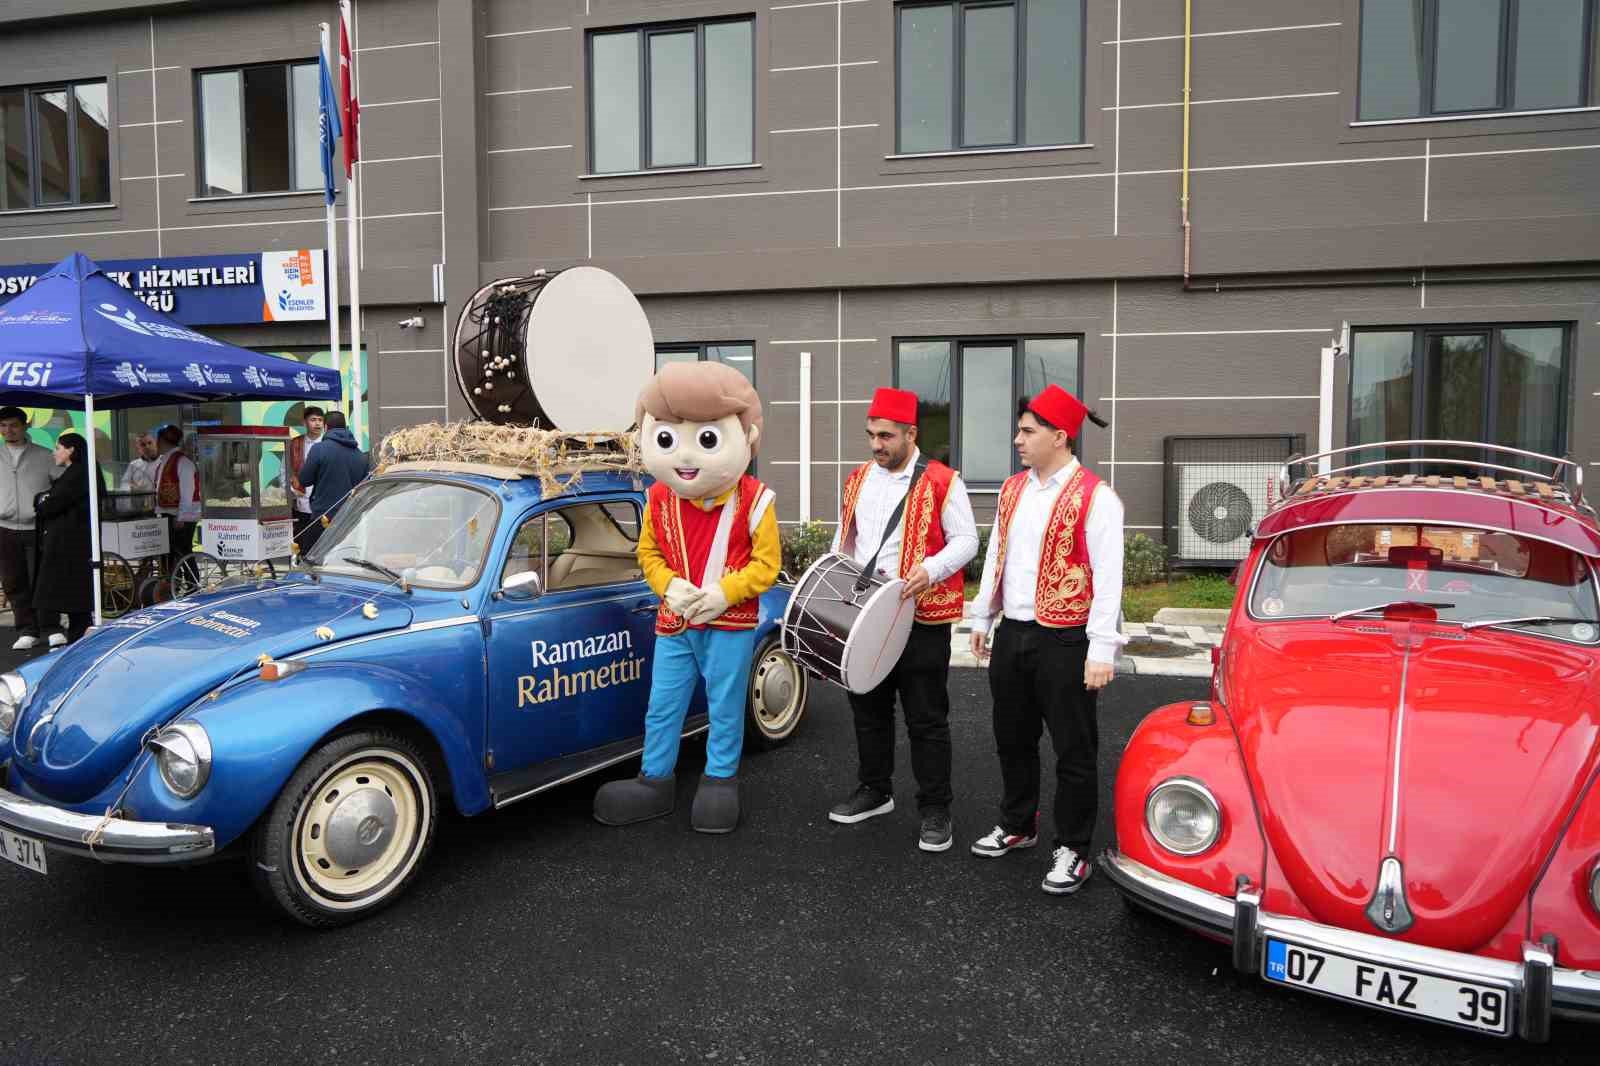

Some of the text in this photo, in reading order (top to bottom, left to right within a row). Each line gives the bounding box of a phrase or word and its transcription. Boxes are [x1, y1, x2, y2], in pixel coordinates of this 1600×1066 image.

[138, 260, 255, 287] HİZMETLERİ
[531, 629, 632, 668] Ramazan
[517, 651, 646, 708] Rahmettir
[14, 837, 43, 869] 374
[1270, 949, 1502, 1027] TR 07 FAZ 39
